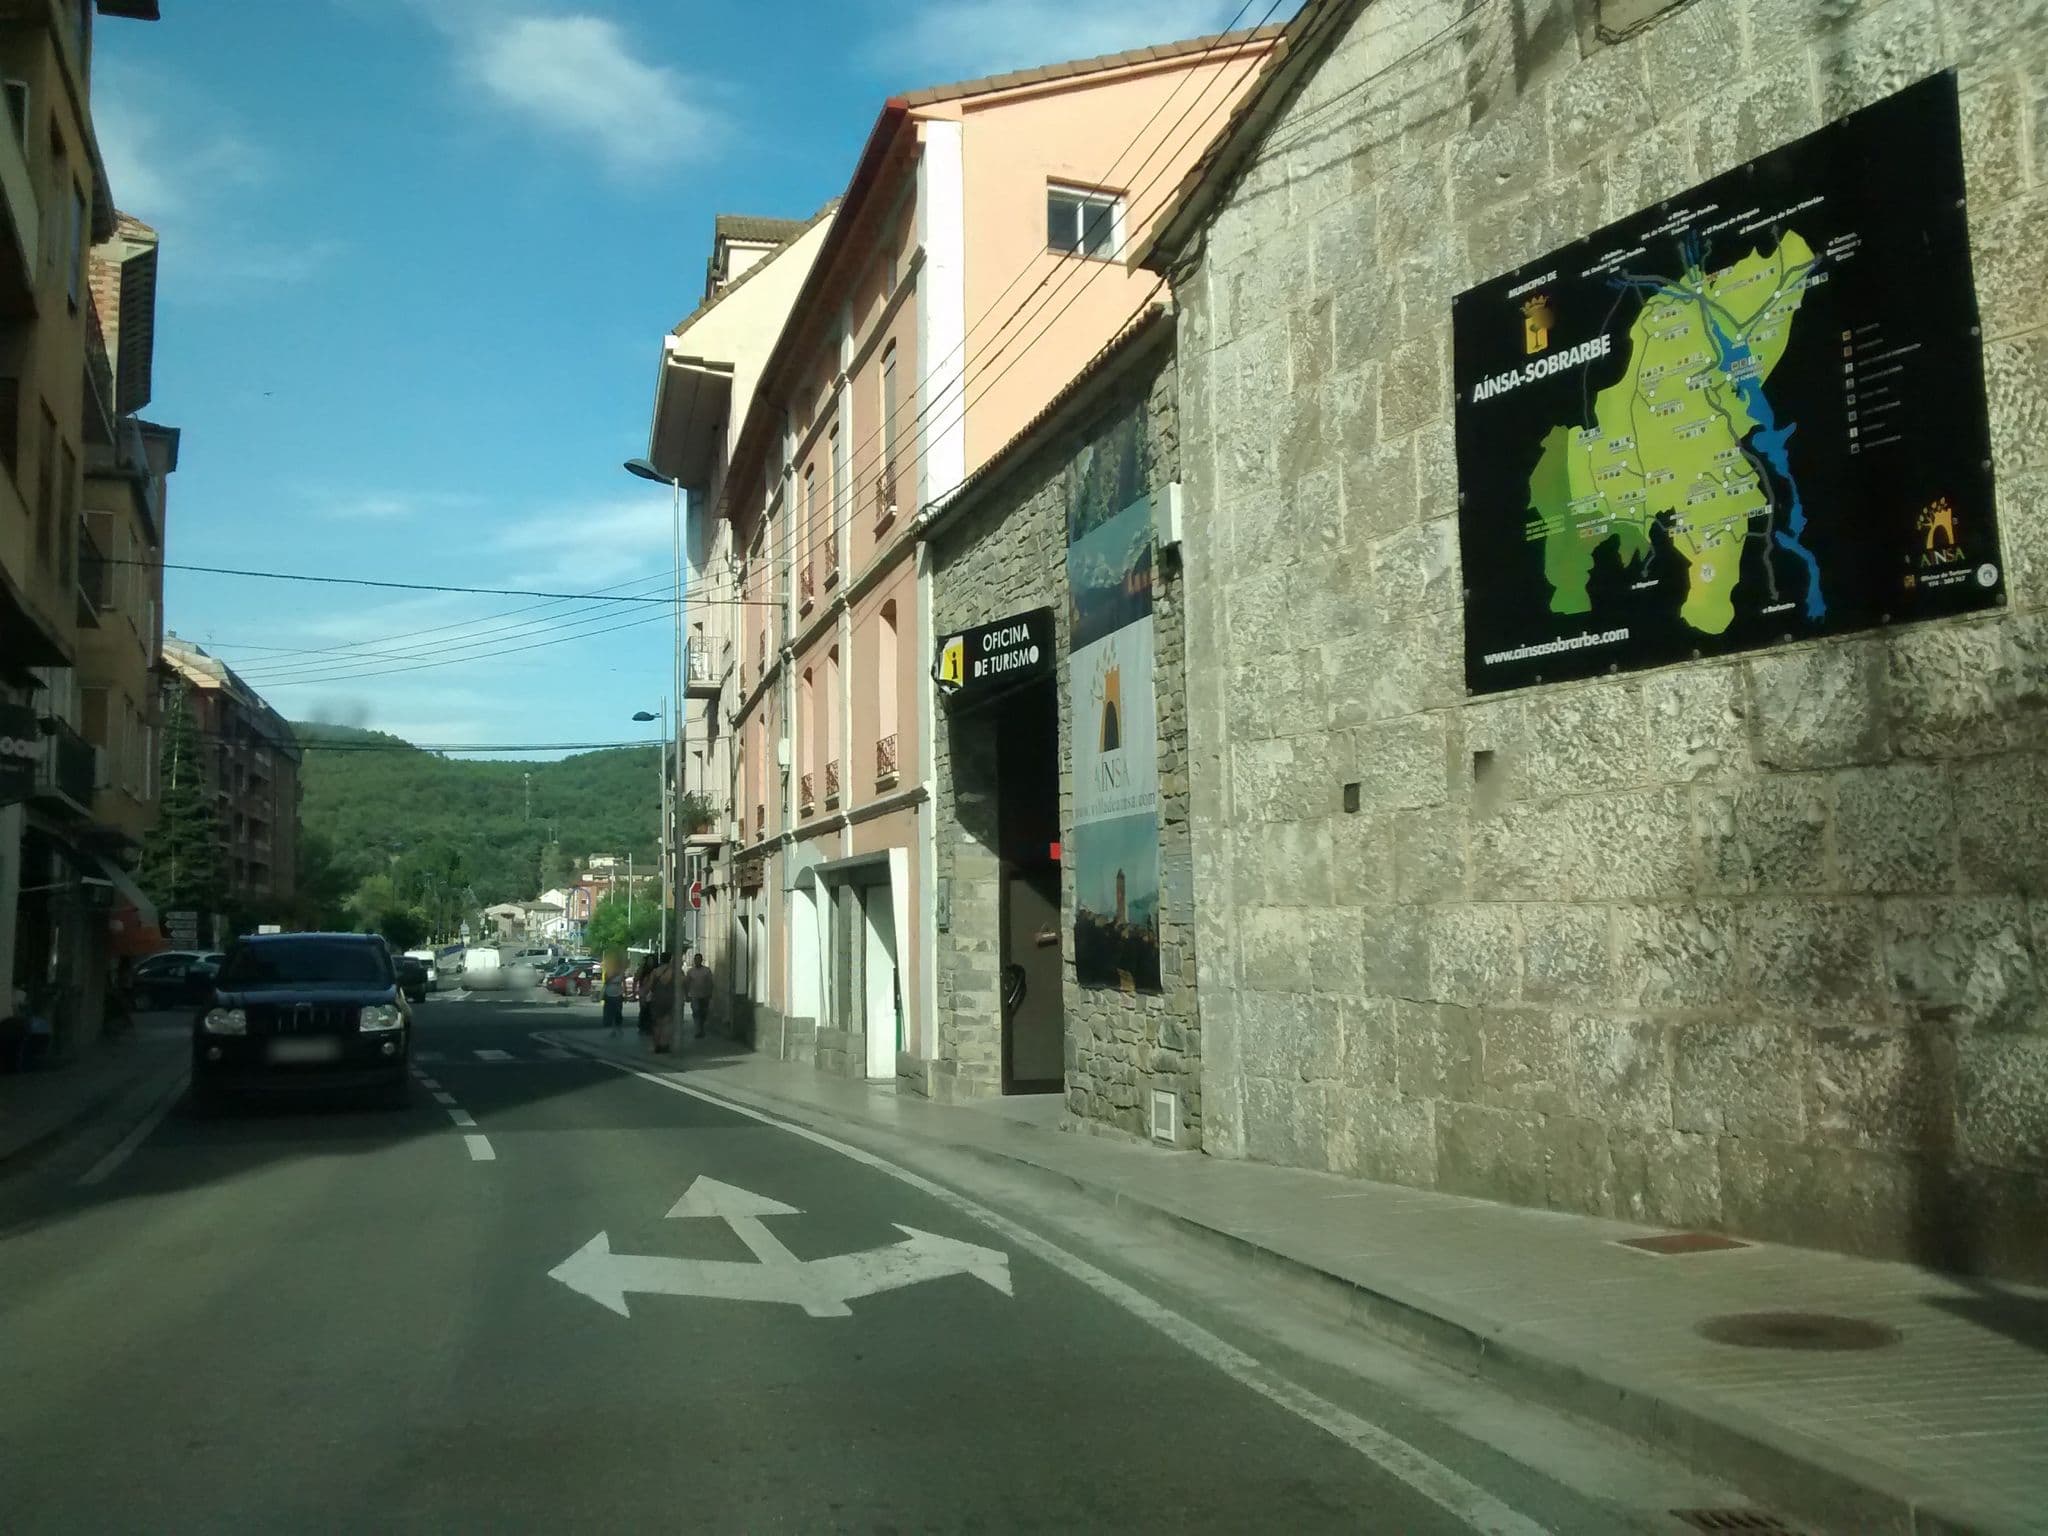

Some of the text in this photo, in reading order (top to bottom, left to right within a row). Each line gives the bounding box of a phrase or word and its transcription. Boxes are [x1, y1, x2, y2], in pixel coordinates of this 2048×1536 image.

[1508, 270, 1558, 299] MUNICIPIO DE
[1473, 333, 1611, 403] AÍNSA-SOBRARBE
[982, 623, 1030, 652] OFICINA
[1484, 627, 1629, 666] www.ainsasobrarbe.com
[974, 645, 1039, 678] DE TURISMO
